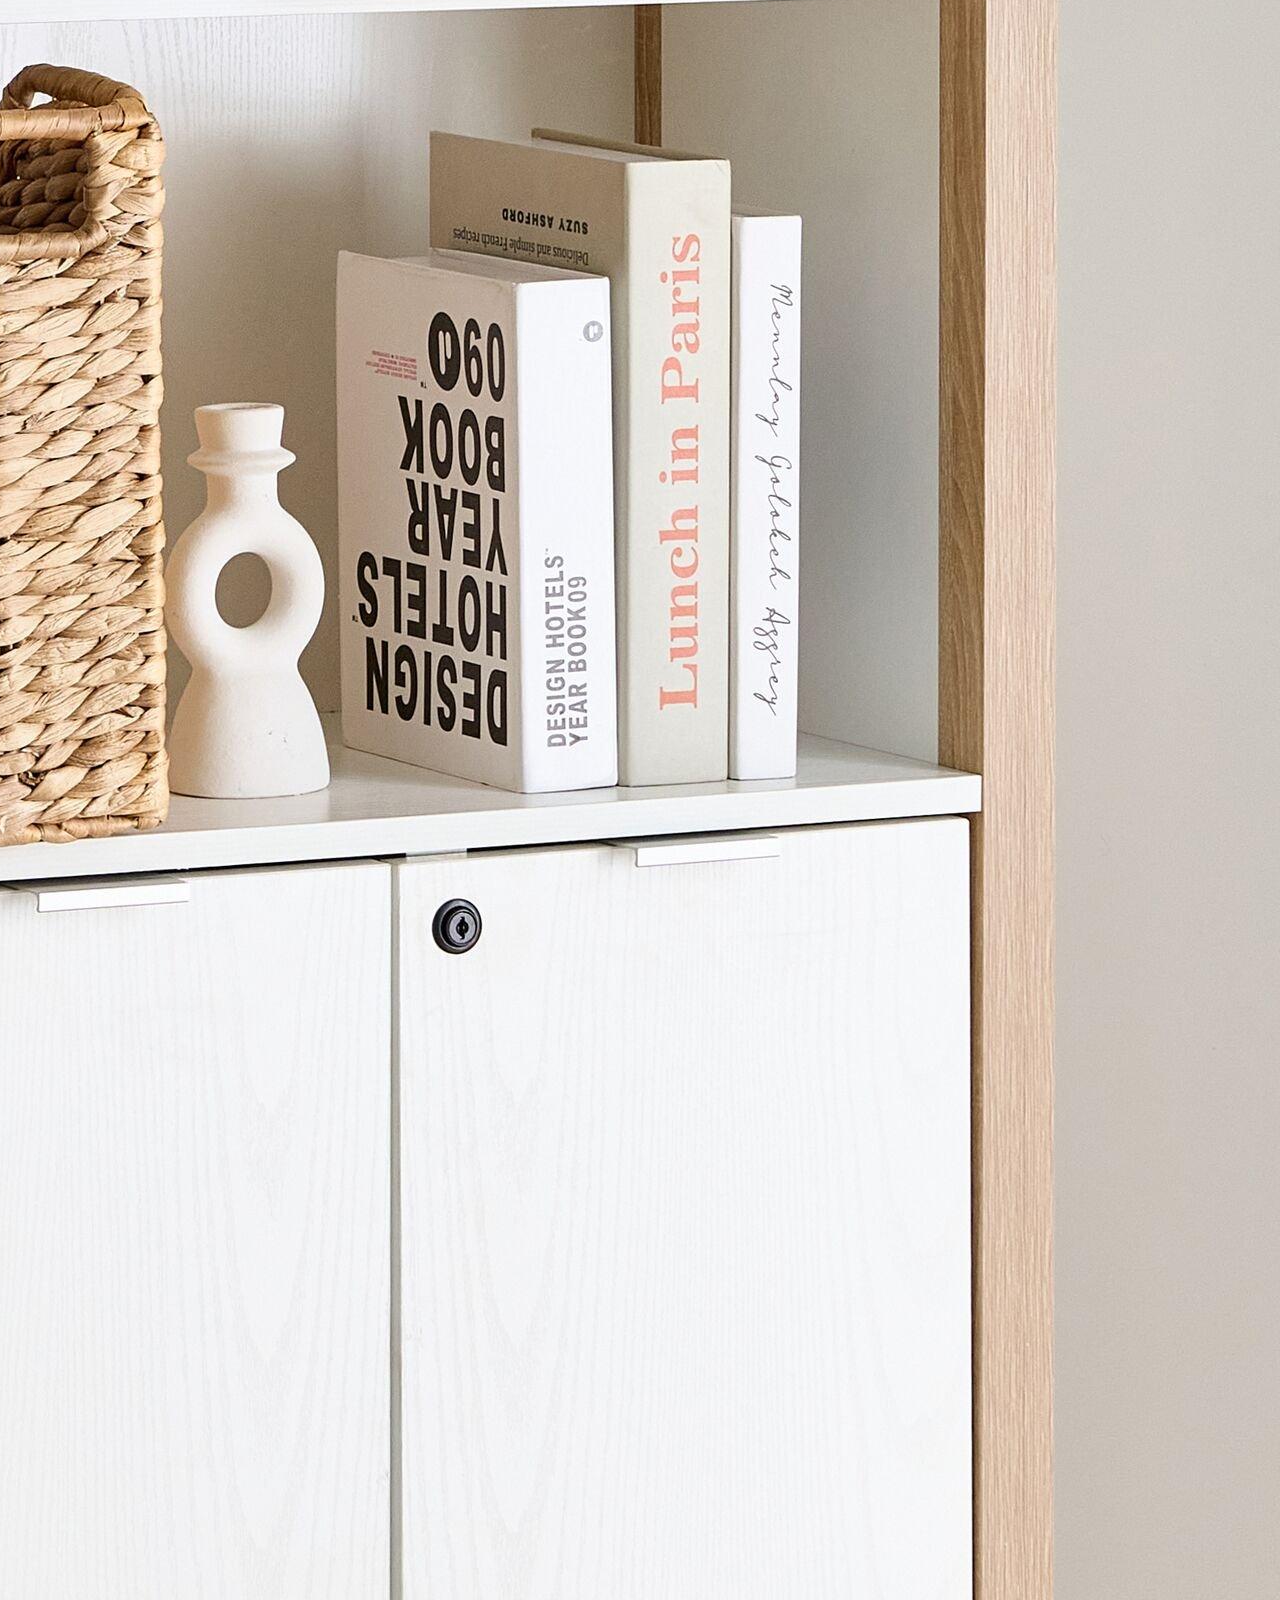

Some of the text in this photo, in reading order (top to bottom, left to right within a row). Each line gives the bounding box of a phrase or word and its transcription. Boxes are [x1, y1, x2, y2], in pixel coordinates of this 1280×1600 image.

[452, 227, 589, 266] Delicious and simple French recipes
[502, 208, 589, 235] SUZY ASHFORD
[397, 394, 506, 493] BOOK
[658, 233, 701, 710] Lunch in Paris
[405, 477, 508, 576] YEAR
[365, 635, 508, 747] DESIGN
[546, 659, 567, 747] DESIGN
[752, 606, 790, 717] Aggrey
[568, 683, 589, 746] YEAR
